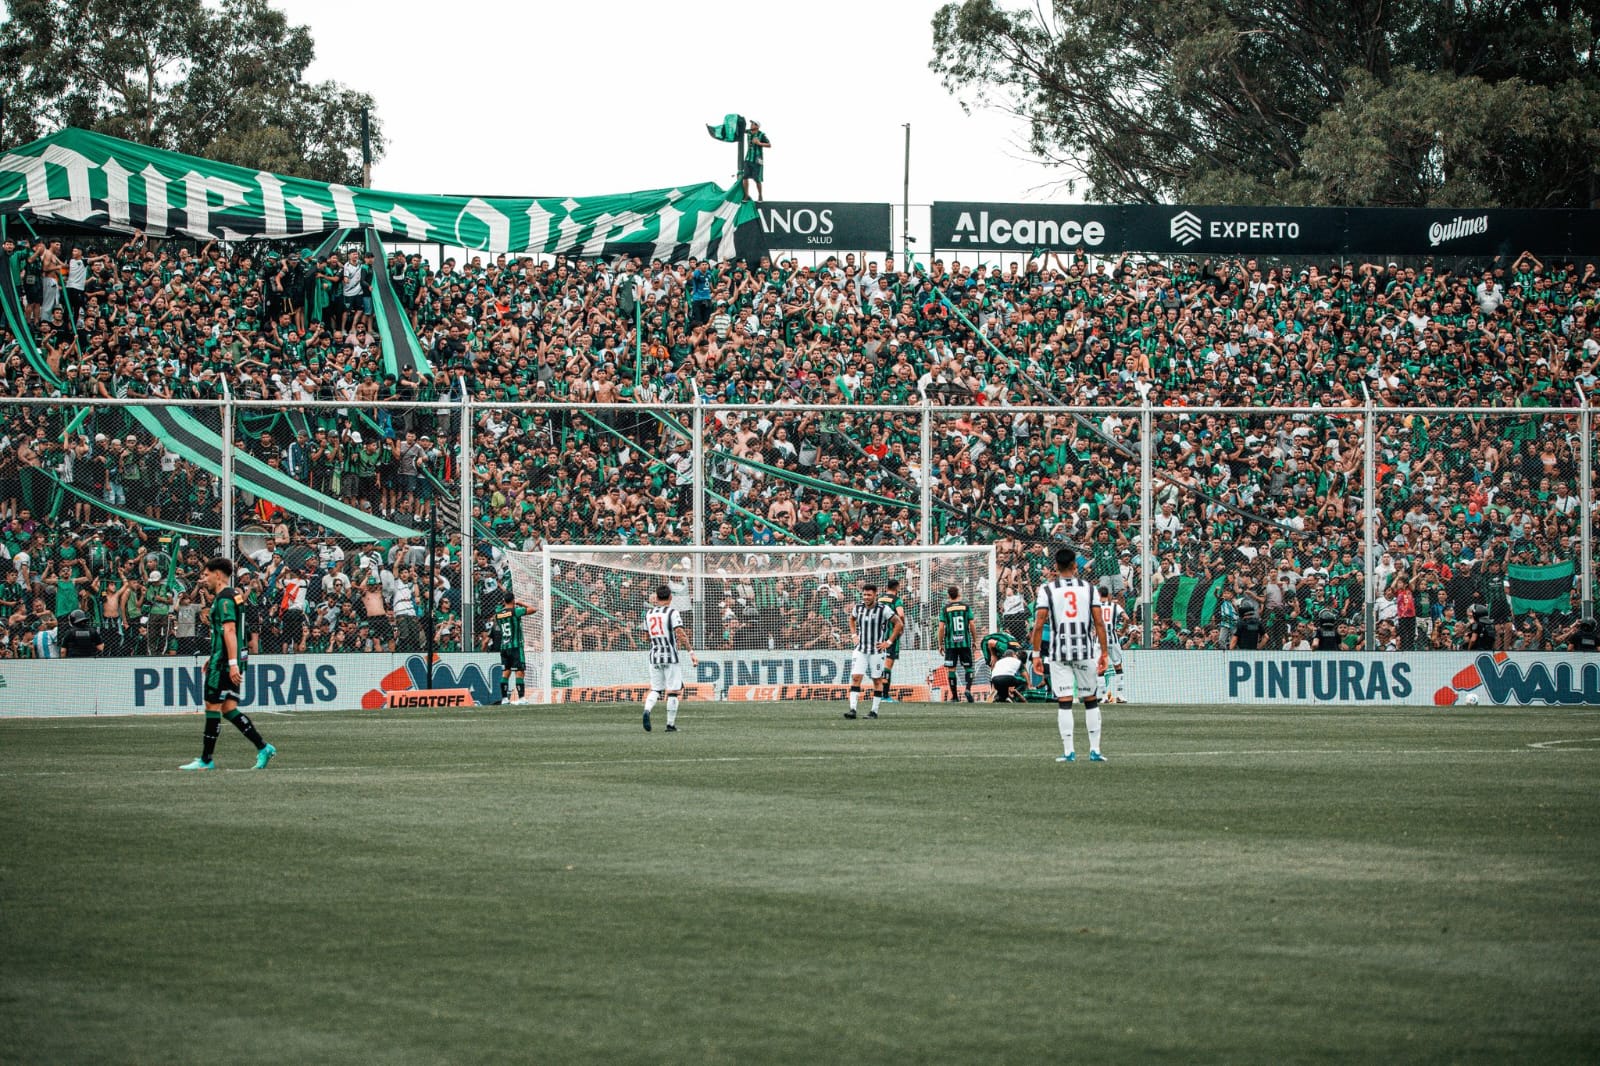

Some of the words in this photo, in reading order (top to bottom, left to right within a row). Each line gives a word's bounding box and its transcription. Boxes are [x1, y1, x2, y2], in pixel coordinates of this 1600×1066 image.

[807, 236, 833, 244] SALUD
[951, 211, 1105, 246] Alcance
[1210, 221, 1299, 239] EXPERTO
[1429, 215, 1488, 247] Quilmes
[1063, 591, 1078, 618] 3
[649, 616, 664, 636] 21
[953, 615, 964, 632] 16
[134, 664, 338, 707] PINURAS
[697, 658, 872, 691] PINTUR
[1229, 660, 1413, 700] PINTURAS
[563, 686, 698, 704] LÜSQTF
[780, 685, 914, 701] LÜSQOF
